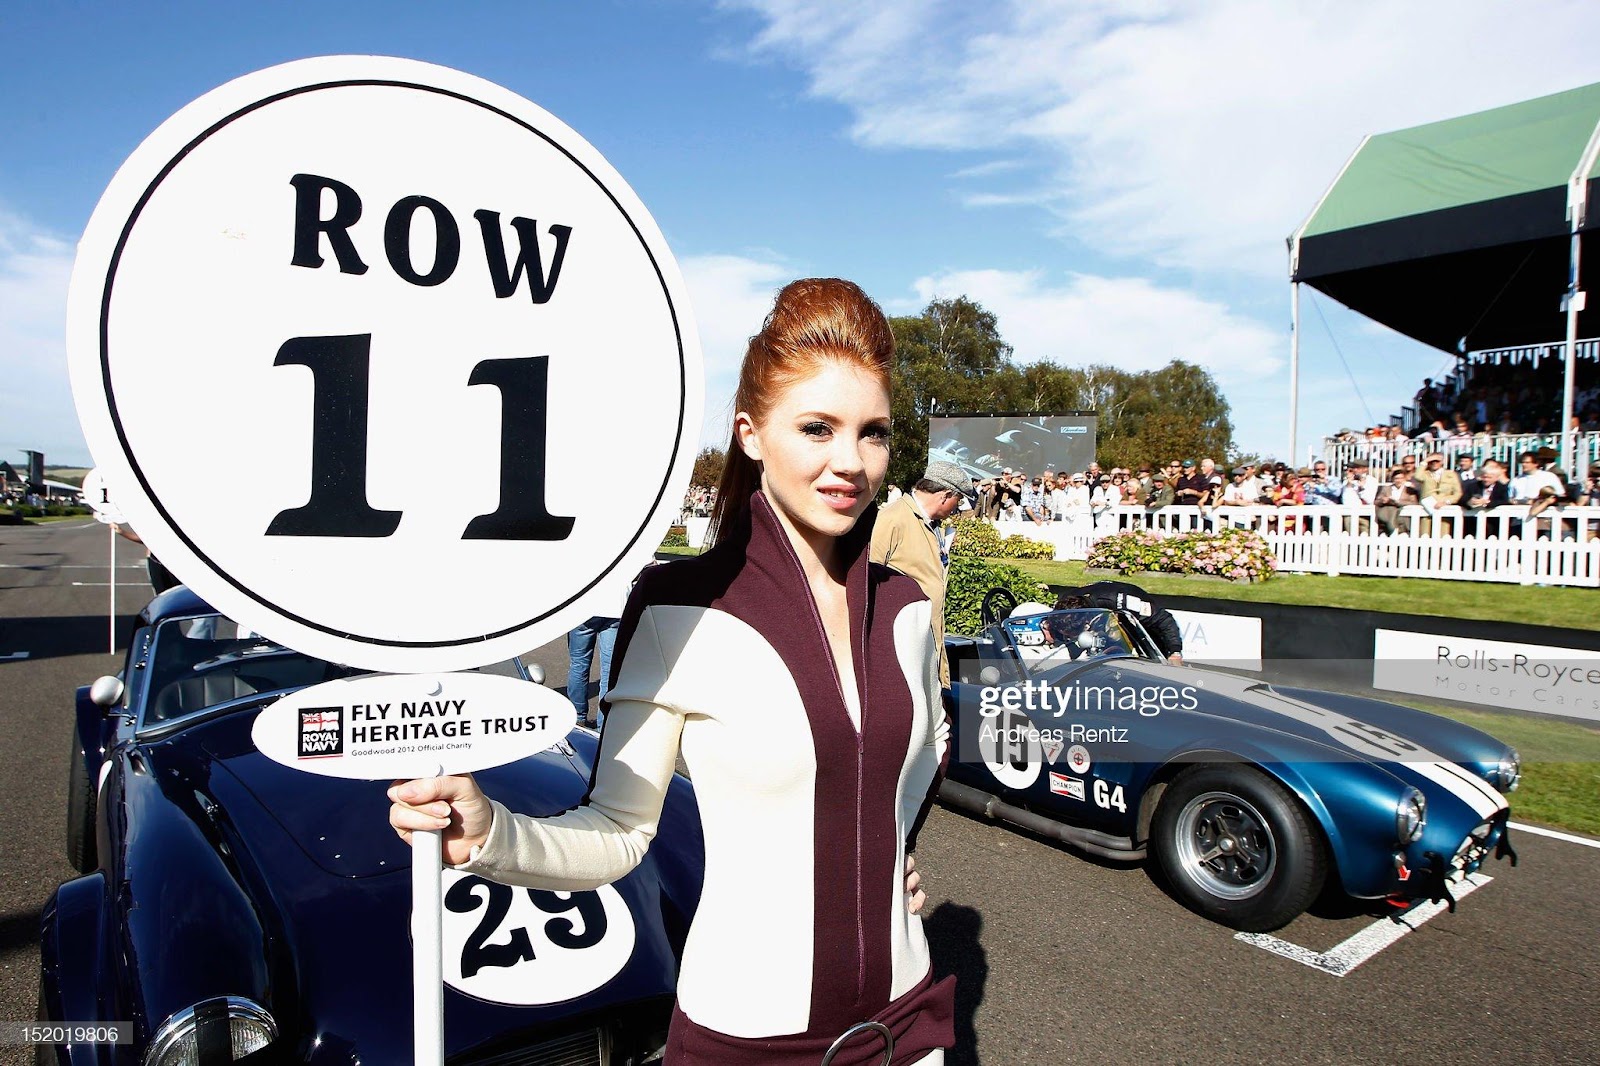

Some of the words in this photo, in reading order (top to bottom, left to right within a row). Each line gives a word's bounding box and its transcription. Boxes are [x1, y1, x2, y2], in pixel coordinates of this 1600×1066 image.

[289, 173, 573, 304] ROW
[264, 333, 576, 541] 11
[1437, 645, 1600, 686] Rolls-Royce
[352, 703, 391, 721] FLY
[401, 699, 466, 718] NAVY
[1435, 676, 1517, 698] Motor
[1533, 688, 1600, 710] Cars
[302, 731, 340, 743] ROYAL
[352, 720, 472, 743] HERITAGE
[481, 715, 549, 735] TRUST
[995, 707, 1029, 772] 15
[302, 741, 339, 753] NAVY
[351, 747, 395, 757] Goodwood
[398, 745, 415, 754] 2012
[418, 743, 444, 752] Official
[446, 742, 472, 751] Charity
[1052, 779, 1082, 794] CHAMPION
[1093, 779, 1127, 813] G4
[444, 874, 608, 979] 29
